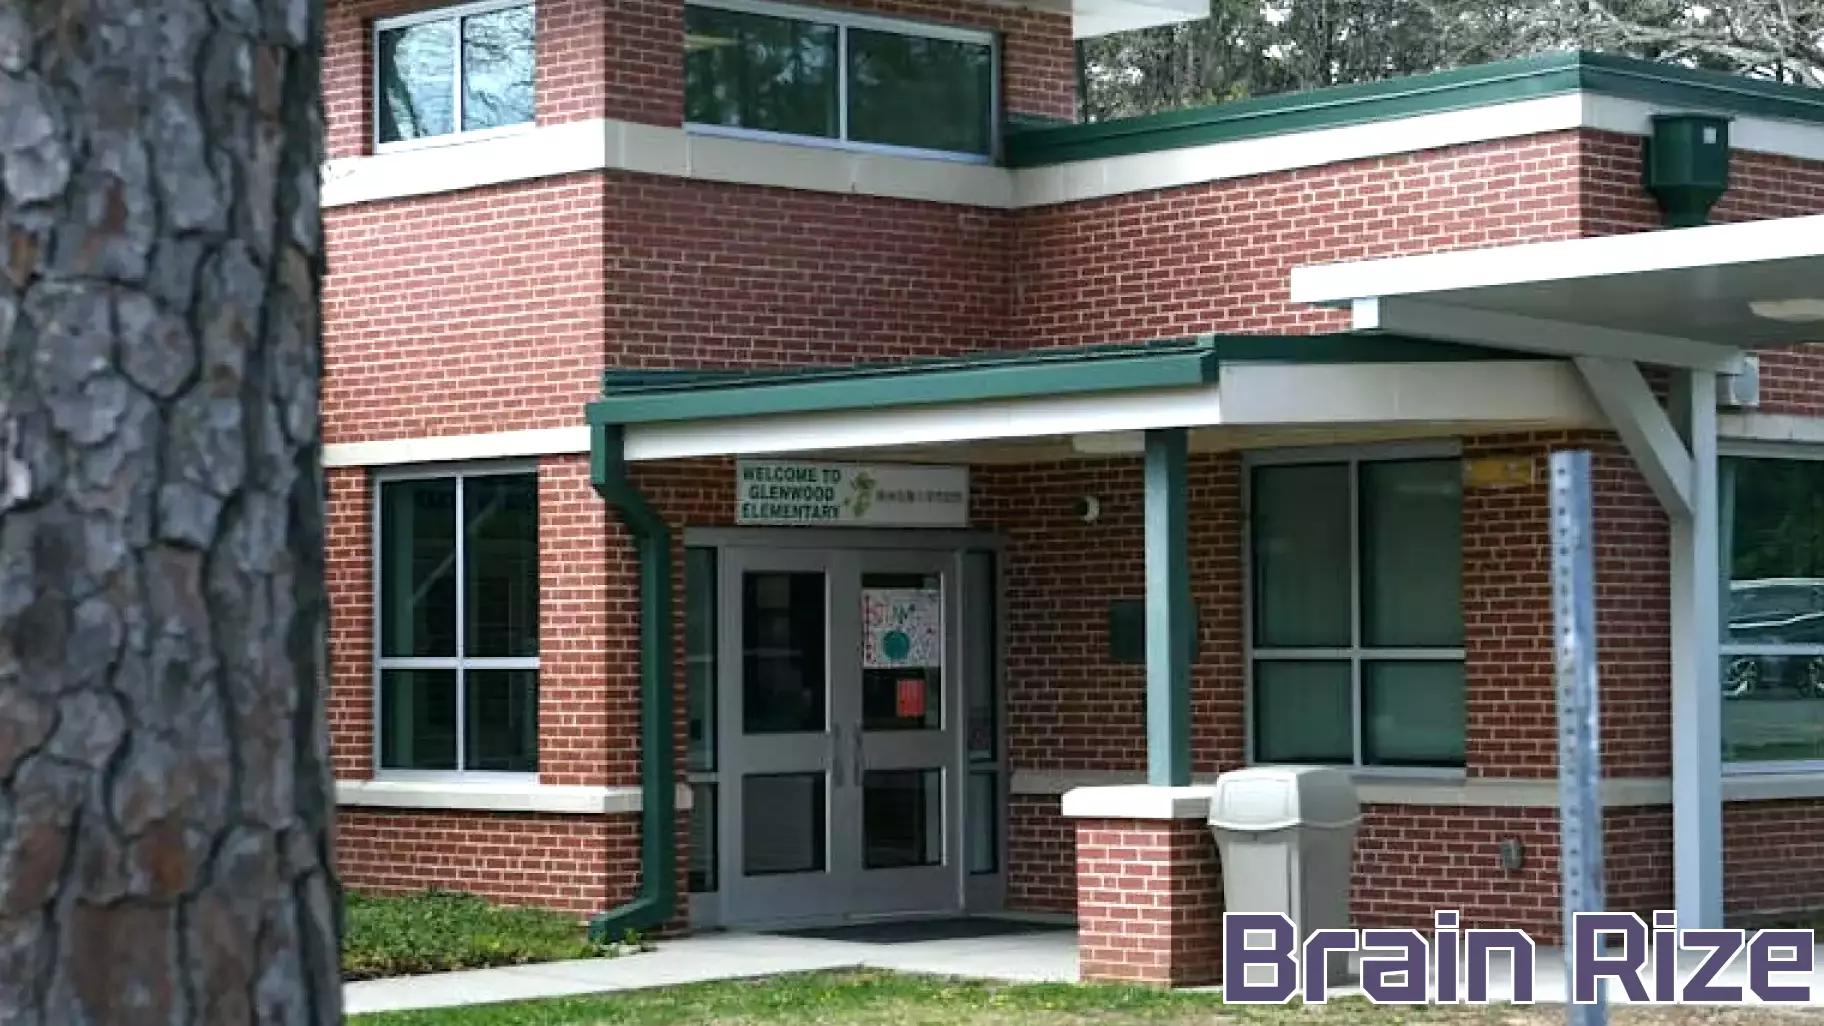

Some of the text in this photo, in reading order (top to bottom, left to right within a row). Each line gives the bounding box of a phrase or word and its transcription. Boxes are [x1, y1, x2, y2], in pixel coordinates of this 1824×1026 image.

[743, 466, 841, 483] WELCOME TO
[748, 485, 834, 501] GLENWOOD
[742, 503, 839, 520] ELEMENTARY
